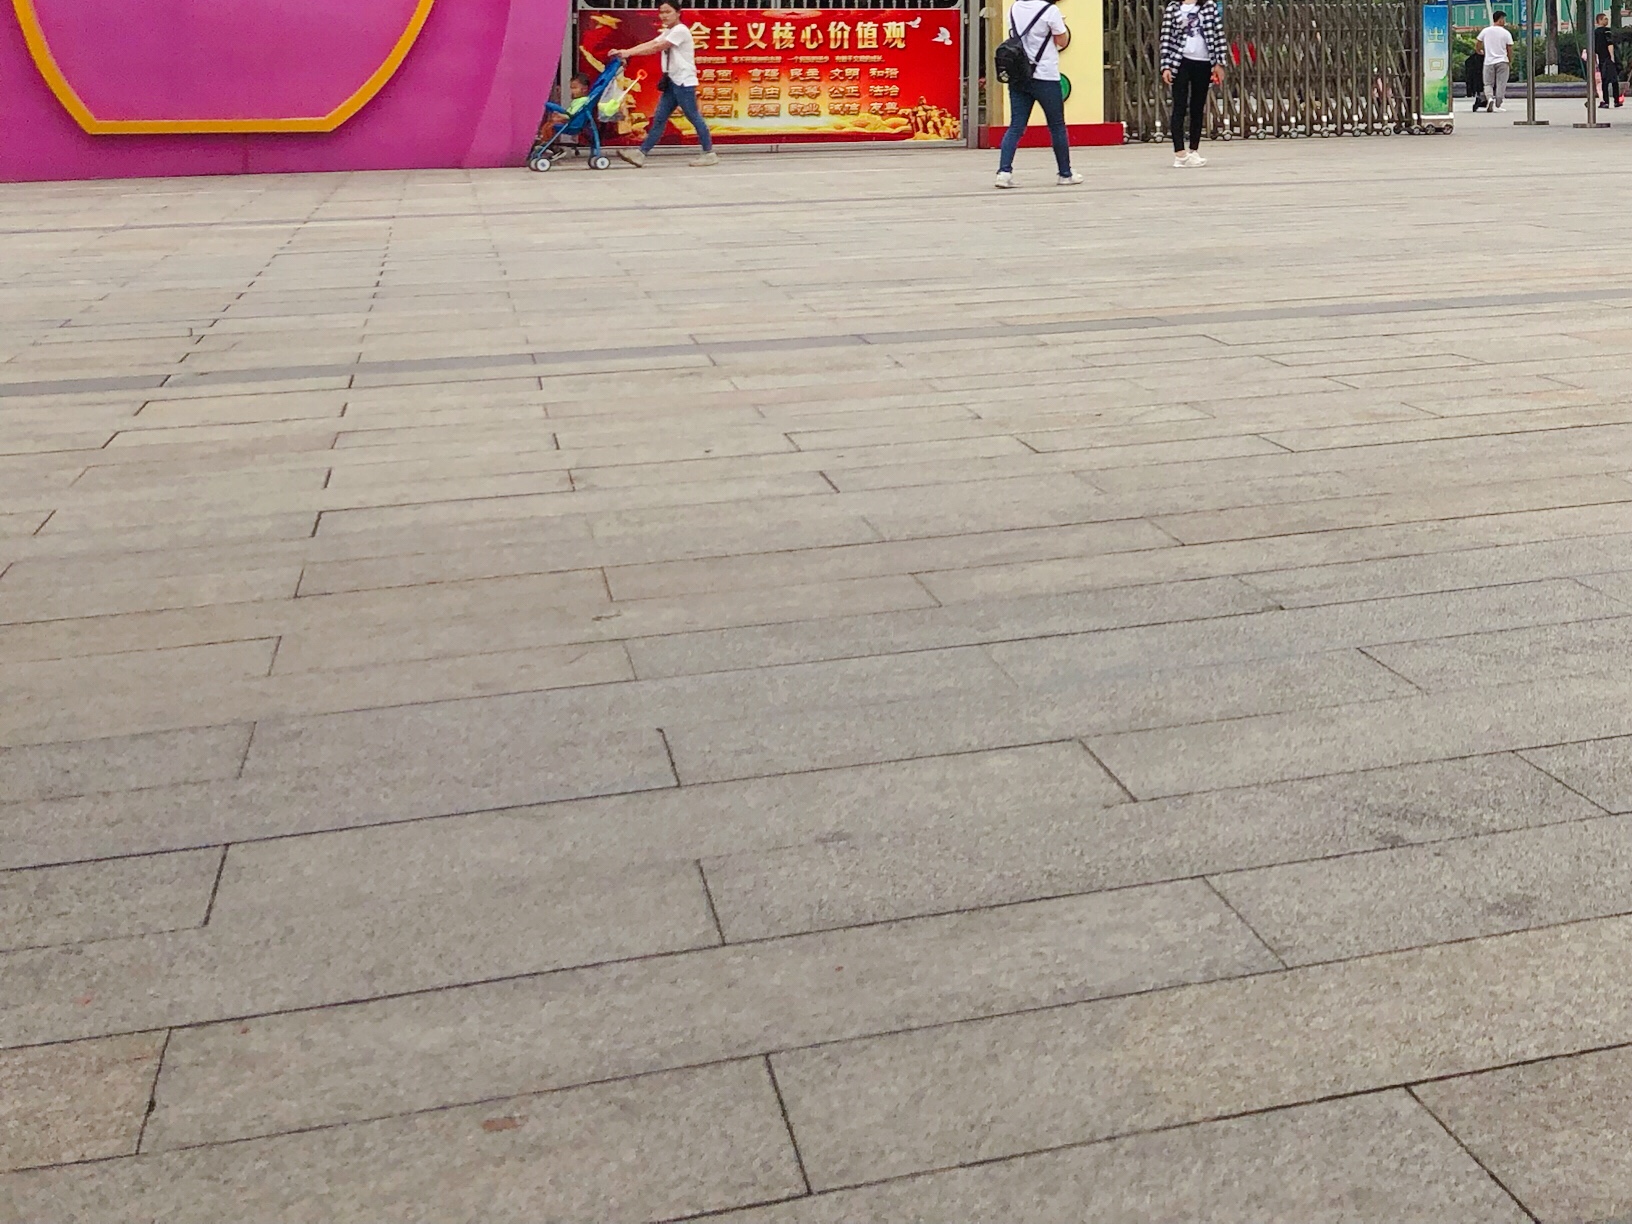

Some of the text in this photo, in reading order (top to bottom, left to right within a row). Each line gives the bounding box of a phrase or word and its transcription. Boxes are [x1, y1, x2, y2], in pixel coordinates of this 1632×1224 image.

[658, 21, 907, 50] 会主义核心价值观
[1427, 26, 1445, 71] 出口
[829, 68, 861, 80] 文明
[749, 85, 780, 99] 自由
[829, 86, 861, 98] 公正
